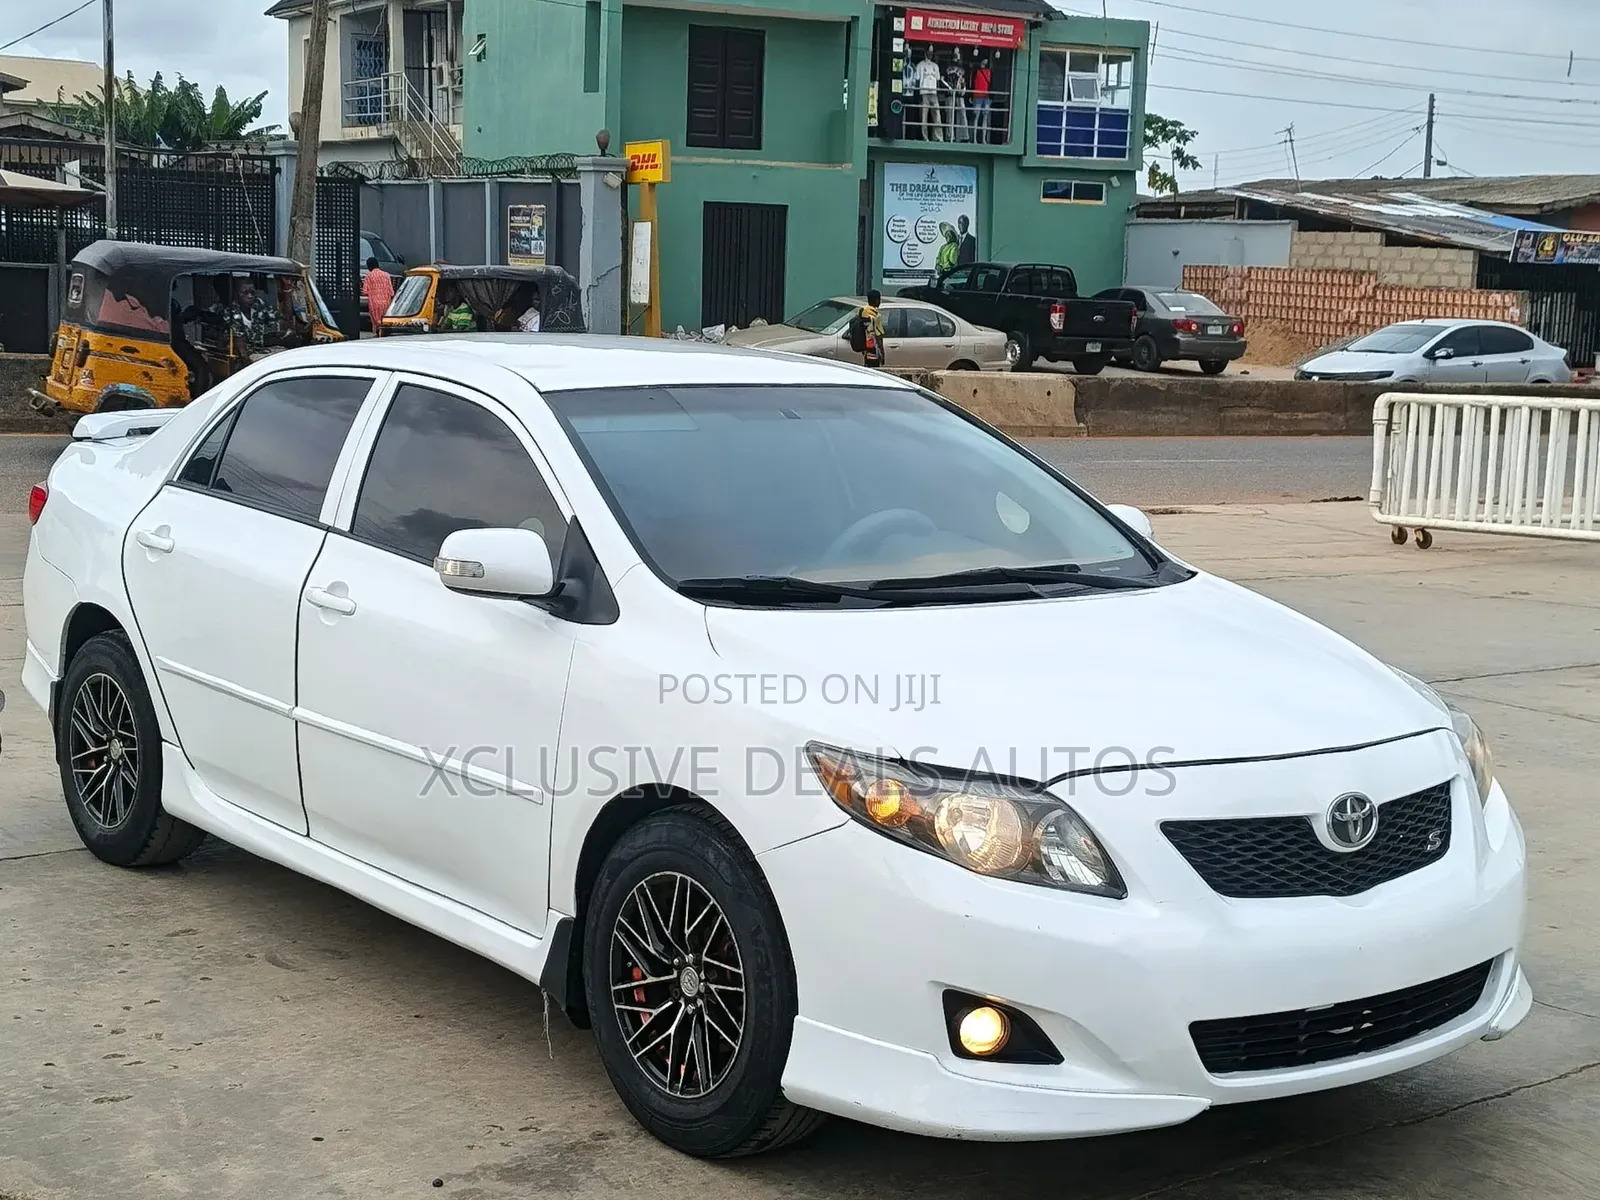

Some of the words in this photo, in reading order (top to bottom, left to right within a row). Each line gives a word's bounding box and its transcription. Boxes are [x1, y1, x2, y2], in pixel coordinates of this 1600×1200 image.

[630, 153, 659, 171] DHL
[889, 183, 908, 192] THE
[909, 183, 939, 193] DREAM
[940, 184, 973, 194] CENTRE
[1427, 829, 1442, 851] S
